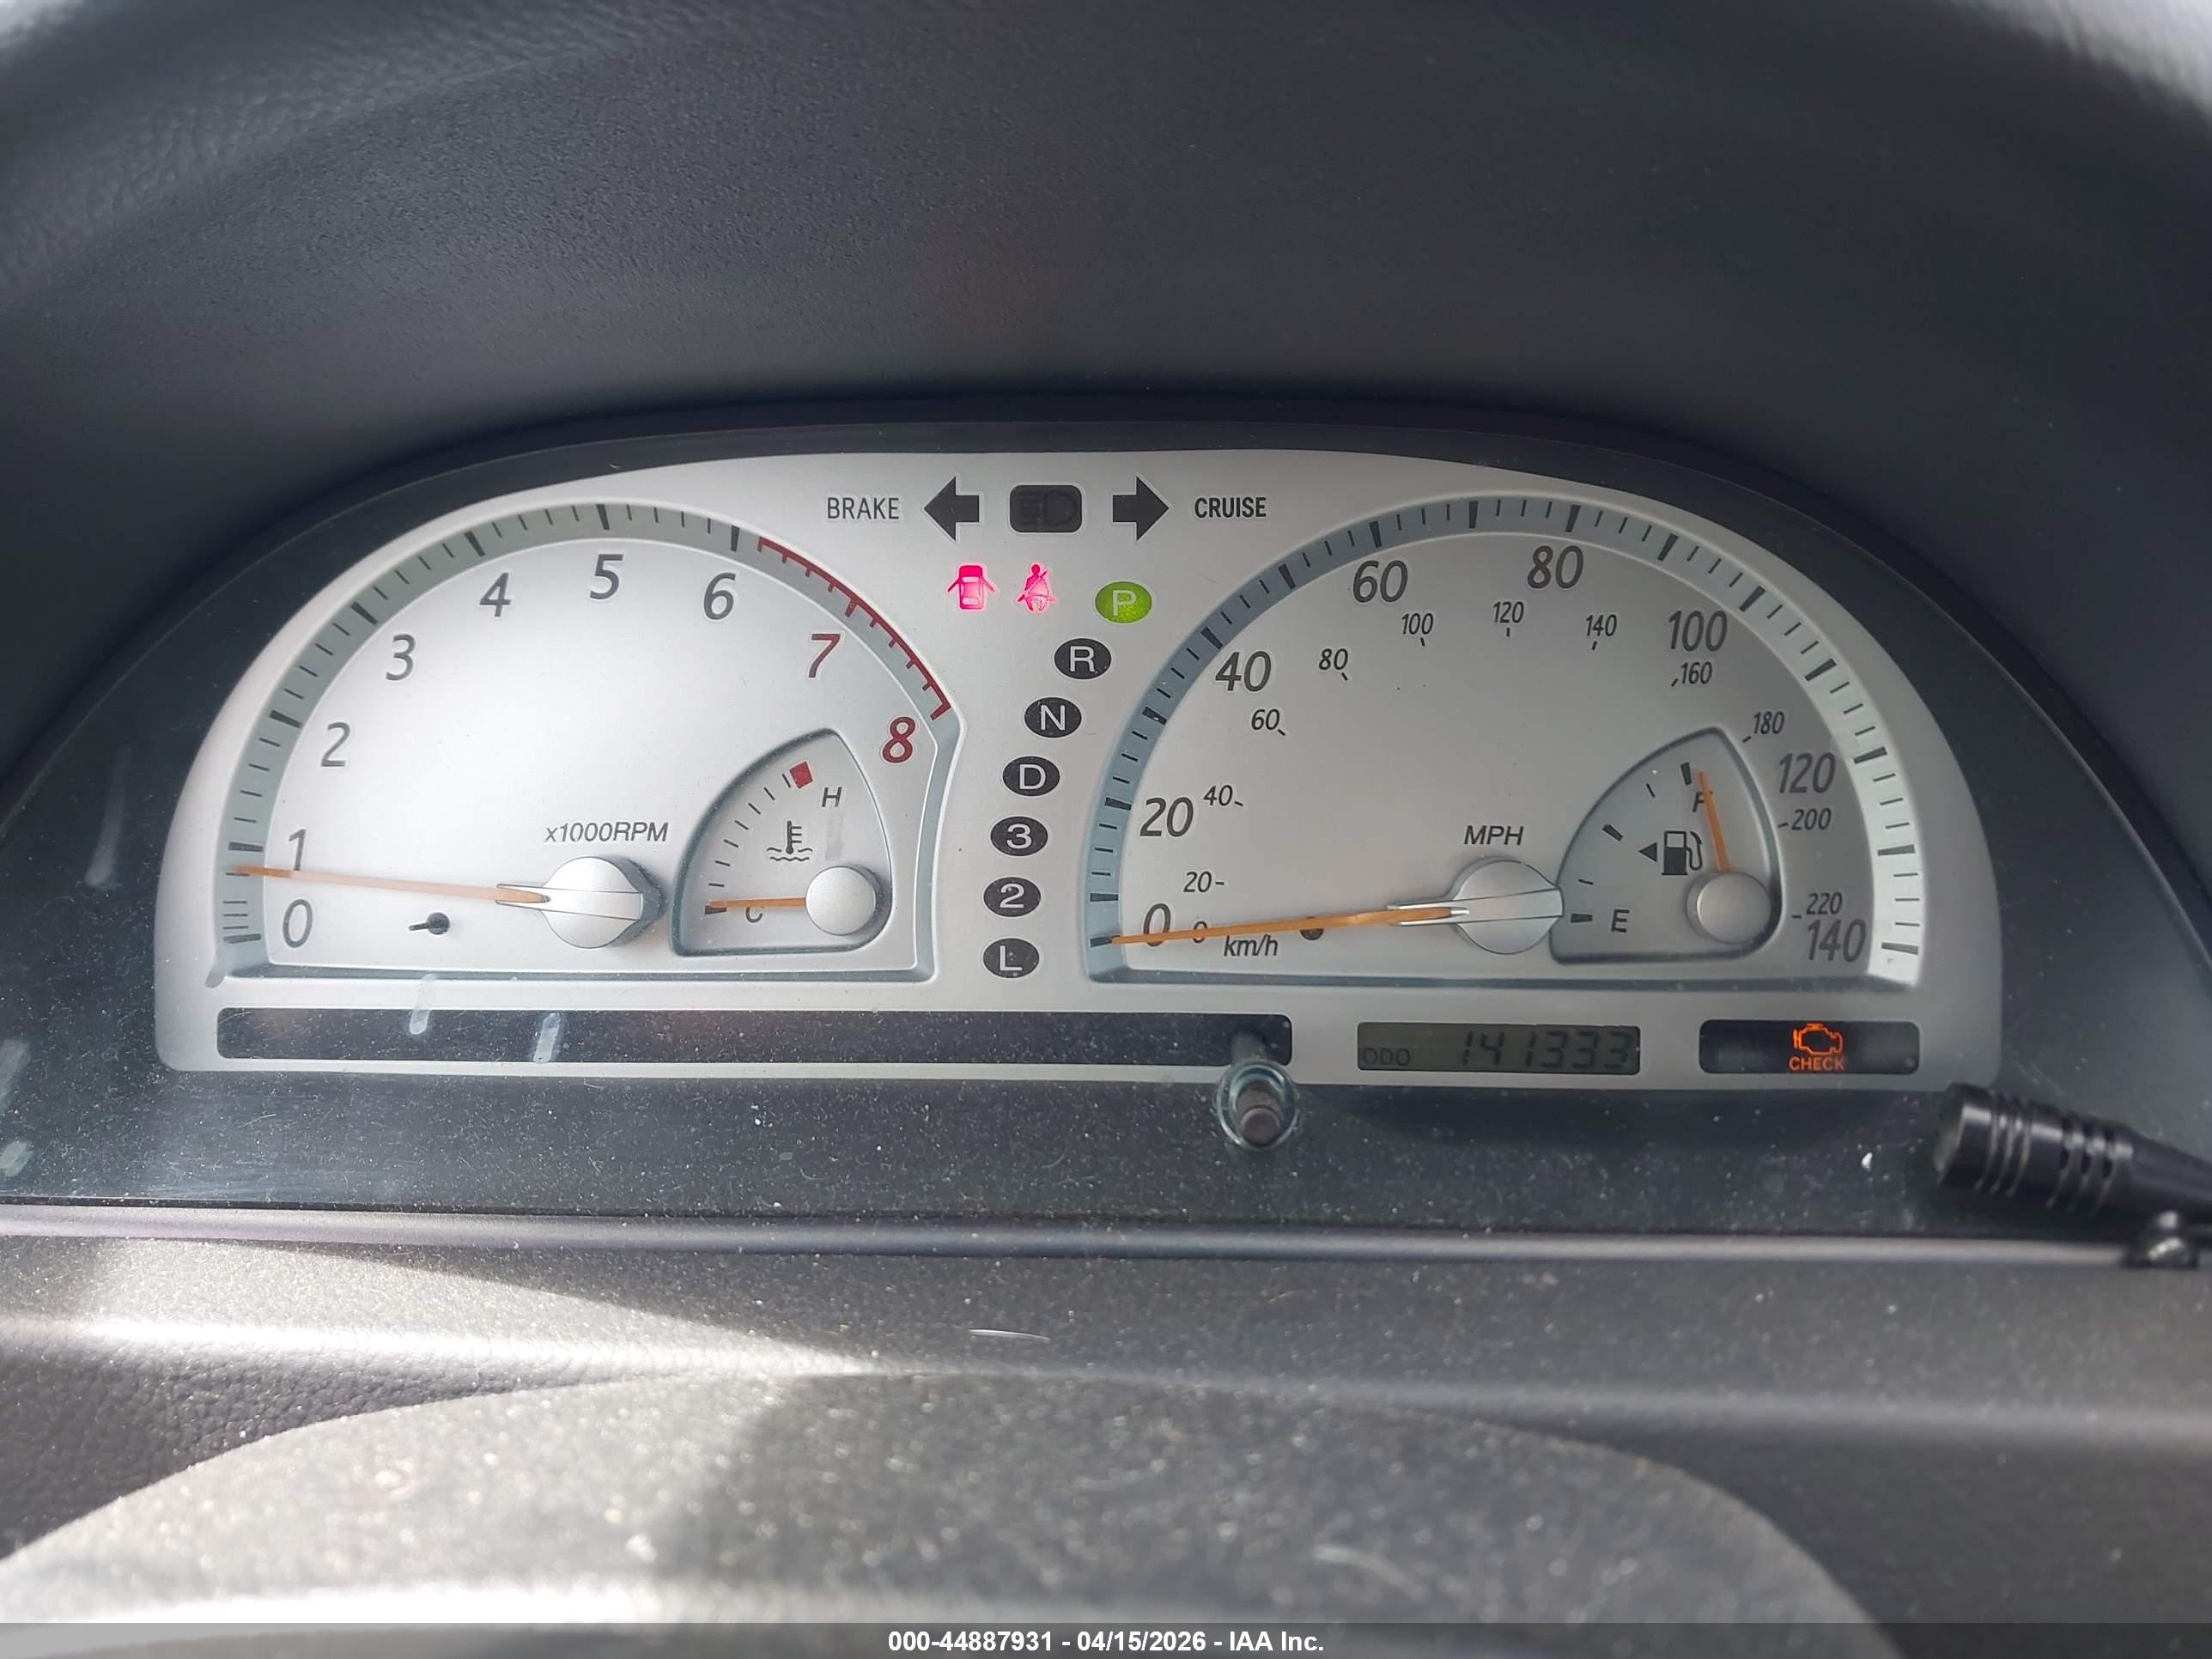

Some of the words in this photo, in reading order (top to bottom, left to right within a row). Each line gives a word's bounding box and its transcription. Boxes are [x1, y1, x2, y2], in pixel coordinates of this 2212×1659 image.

[827, 497, 899, 520] BRAKE
[1194, 496, 1267, 519] CRUISE
[590, 554, 623, 599] 5
[1527, 545, 1584, 589] 80
[1352, 560, 1408, 603] 60
[479, 572, 511, 617] 4
[703, 573, 737, 620] 6
[1113, 590, 1136, 617] P
[1401, 612, 1434, 635] 100
[1492, 601, 1524, 623] 120
[1585, 614, 1617, 637] 140
[1668, 611, 1728, 652] 100
[386, 634, 416, 681] 3
[806, 633, 841, 678] 7
[1069, 647, 1095, 672] R
[1319, 648, 1348, 671] 80
[1215, 651, 1272, 692] 40
[1680, 662, 1712, 684] 160
[1040, 705, 1066, 731] N
[1251, 708, 1280, 732] 60
[1753, 712, 1785, 735] 180
[320, 722, 350, 767] 2
[882, 716, 917, 763] 8
[1018, 763, 1047, 790] D
[1778, 753, 1836, 793] 120
[822, 787, 842, 807] H
[1203, 785, 1233, 806] 40
[1140, 798, 1194, 836] 20
[1790, 808, 1832, 830] 200
[545, 822, 668, 842] x1000RPM
[1007, 823, 1033, 848] 3
[1464, 825, 1524, 846] MPH
[288, 830, 306, 871] 1
[1183, 872, 1212, 893] 20
[1000, 884, 1024, 908] 2
[1807, 894, 1843, 915] 220
[283, 899, 313, 947] 0
[1143, 902, 1171, 947] 0
[1611, 910, 1630, 933] E
[1224, 934, 1279, 957] km/h
[1807, 920, 1866, 962] 140
[1000, 945, 1023, 971] L
[1362, 1047, 1412, 1066] ODO
[1462, 1030, 1631, 1070] 141333
[1789, 1056, 1845, 1072] CHECK
